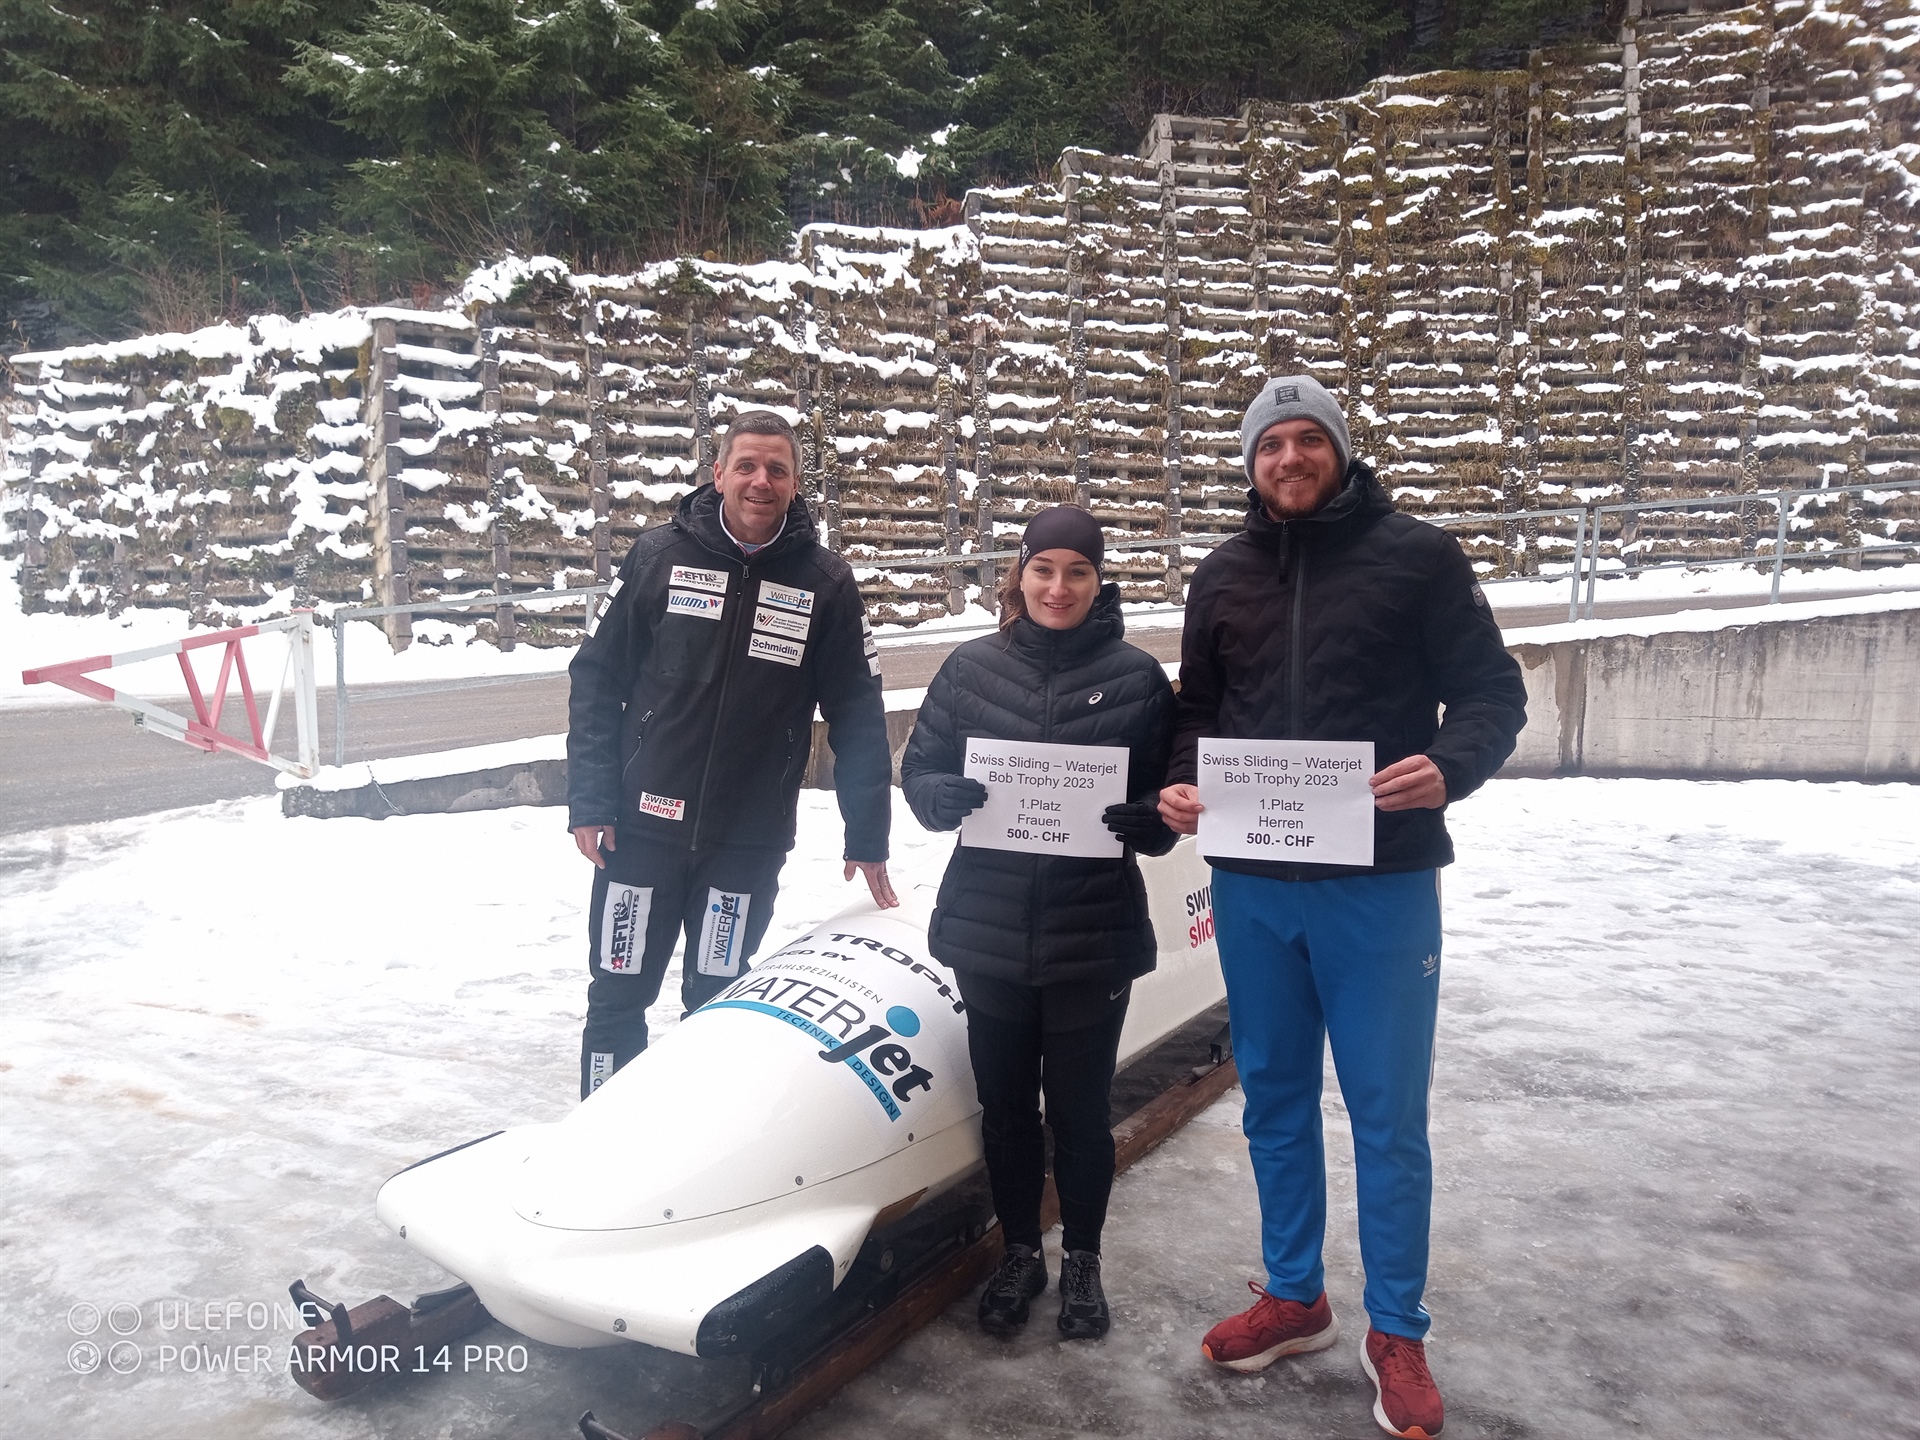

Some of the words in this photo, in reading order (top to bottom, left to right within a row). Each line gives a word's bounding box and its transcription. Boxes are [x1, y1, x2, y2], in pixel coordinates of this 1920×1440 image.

[670, 595, 709, 609] wams
[770, 591, 812, 609] WATERjet
[752, 638, 798, 656] Schmidlin
[970, 753, 1004, 766] Swiss
[1008, 756, 1050, 772] Sliding
[1065, 760, 1118, 776] Waterjet
[1202, 753, 1239, 766] Swiss
[1244, 755, 1288, 770] Sliding
[1305, 757, 1362, 772] Waterjet
[988, 771, 1013, 784] Bob
[1017, 773, 1060, 789] Trophy
[1063, 777, 1095, 789] 2023
[1224, 772, 1250, 783] Bob
[1254, 773, 1300, 787] Trophy
[1304, 775, 1338, 786] 2023
[644, 794, 675, 807] SWISS
[1019, 799, 1061, 812] 1.Platz
[1259, 799, 1304, 811] 1.Platz
[641, 802, 677, 818] sliding
[1017, 814, 1061, 827] Frauen
[1258, 816, 1304, 829] Herren
[1007, 829, 1038, 840] 500.-
[1042, 831, 1070, 843] CHF
[1246, 833, 1280, 846] 500.-
[1284, 835, 1315, 847] CHF
[1186, 886, 1211, 917] SWI
[712, 894, 740, 959] WATERjet
[1189, 909, 1214, 948] slid
[821, 951, 856, 961] BY
[830, 934, 966, 1015] TROPH
[705, 977, 934, 1103] WATERjet
[594, 1055, 605, 1091] DATE
[776, 1010, 838, 1048] TECHNIK
[851, 1060, 898, 1118] DESIGN
